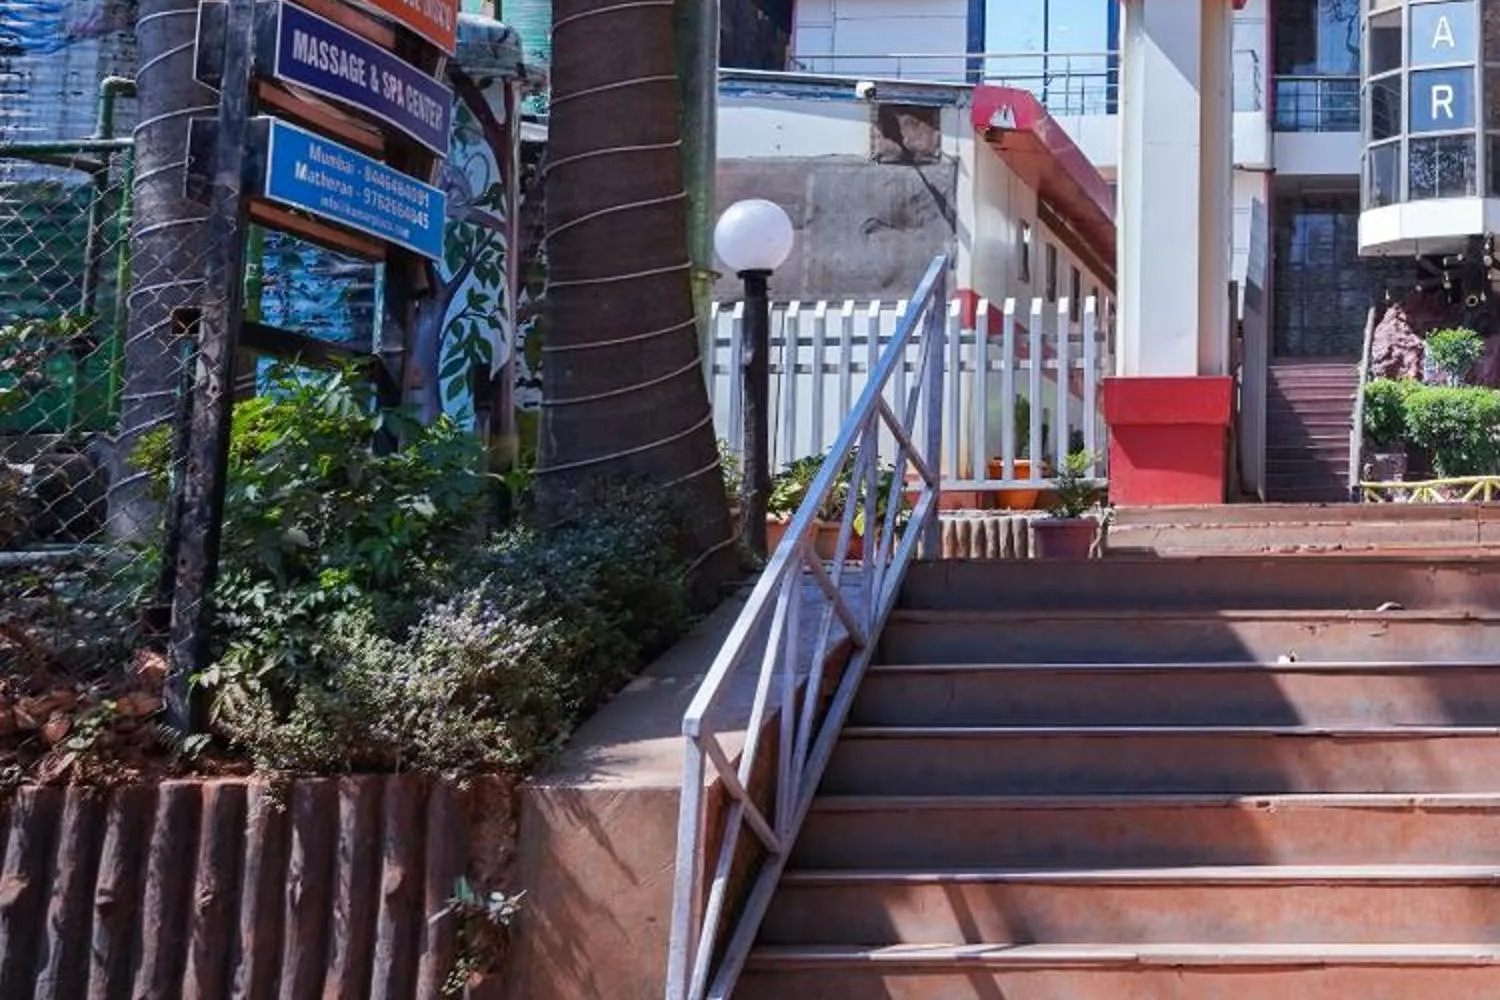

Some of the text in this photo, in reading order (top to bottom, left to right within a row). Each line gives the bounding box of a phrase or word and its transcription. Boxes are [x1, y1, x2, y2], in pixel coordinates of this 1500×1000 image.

[292, 28, 444, 131] MASSAGE & SPA CENTER
[295, 161, 354, 197] Matheran
